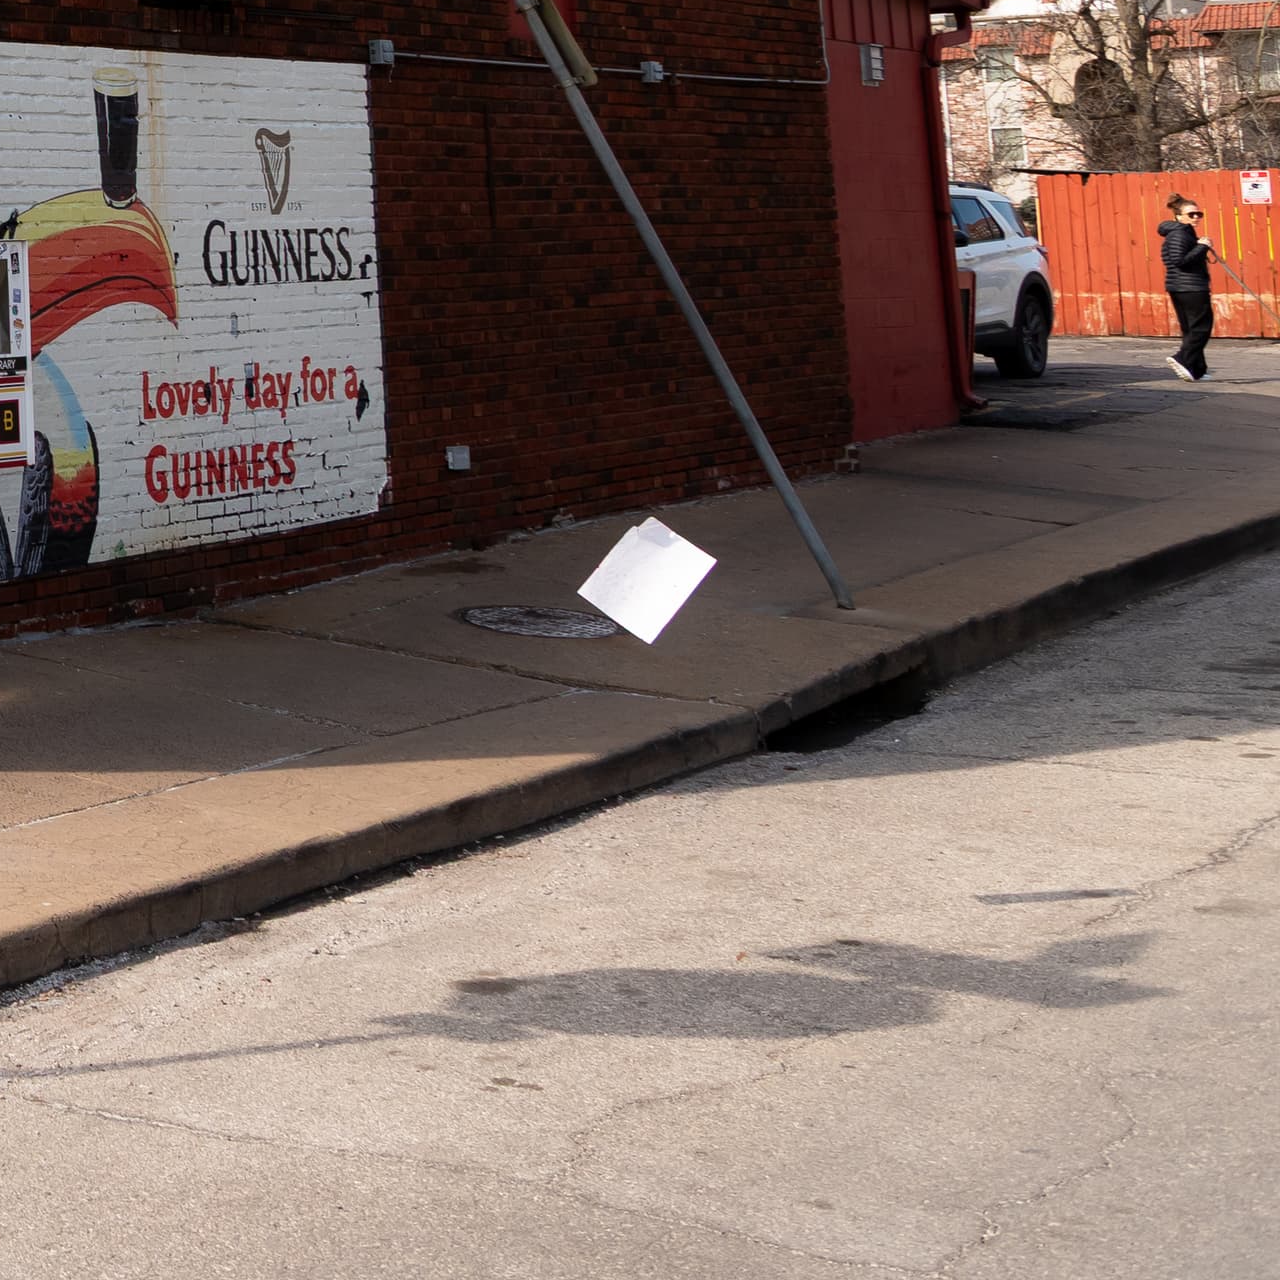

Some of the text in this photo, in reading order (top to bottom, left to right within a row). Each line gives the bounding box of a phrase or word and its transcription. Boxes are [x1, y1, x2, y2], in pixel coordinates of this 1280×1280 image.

[202, 219, 353, 286] GUINNESS
[142, 355, 359, 425] Lovely day for a
[144, 439, 297, 504] GUINNESS
